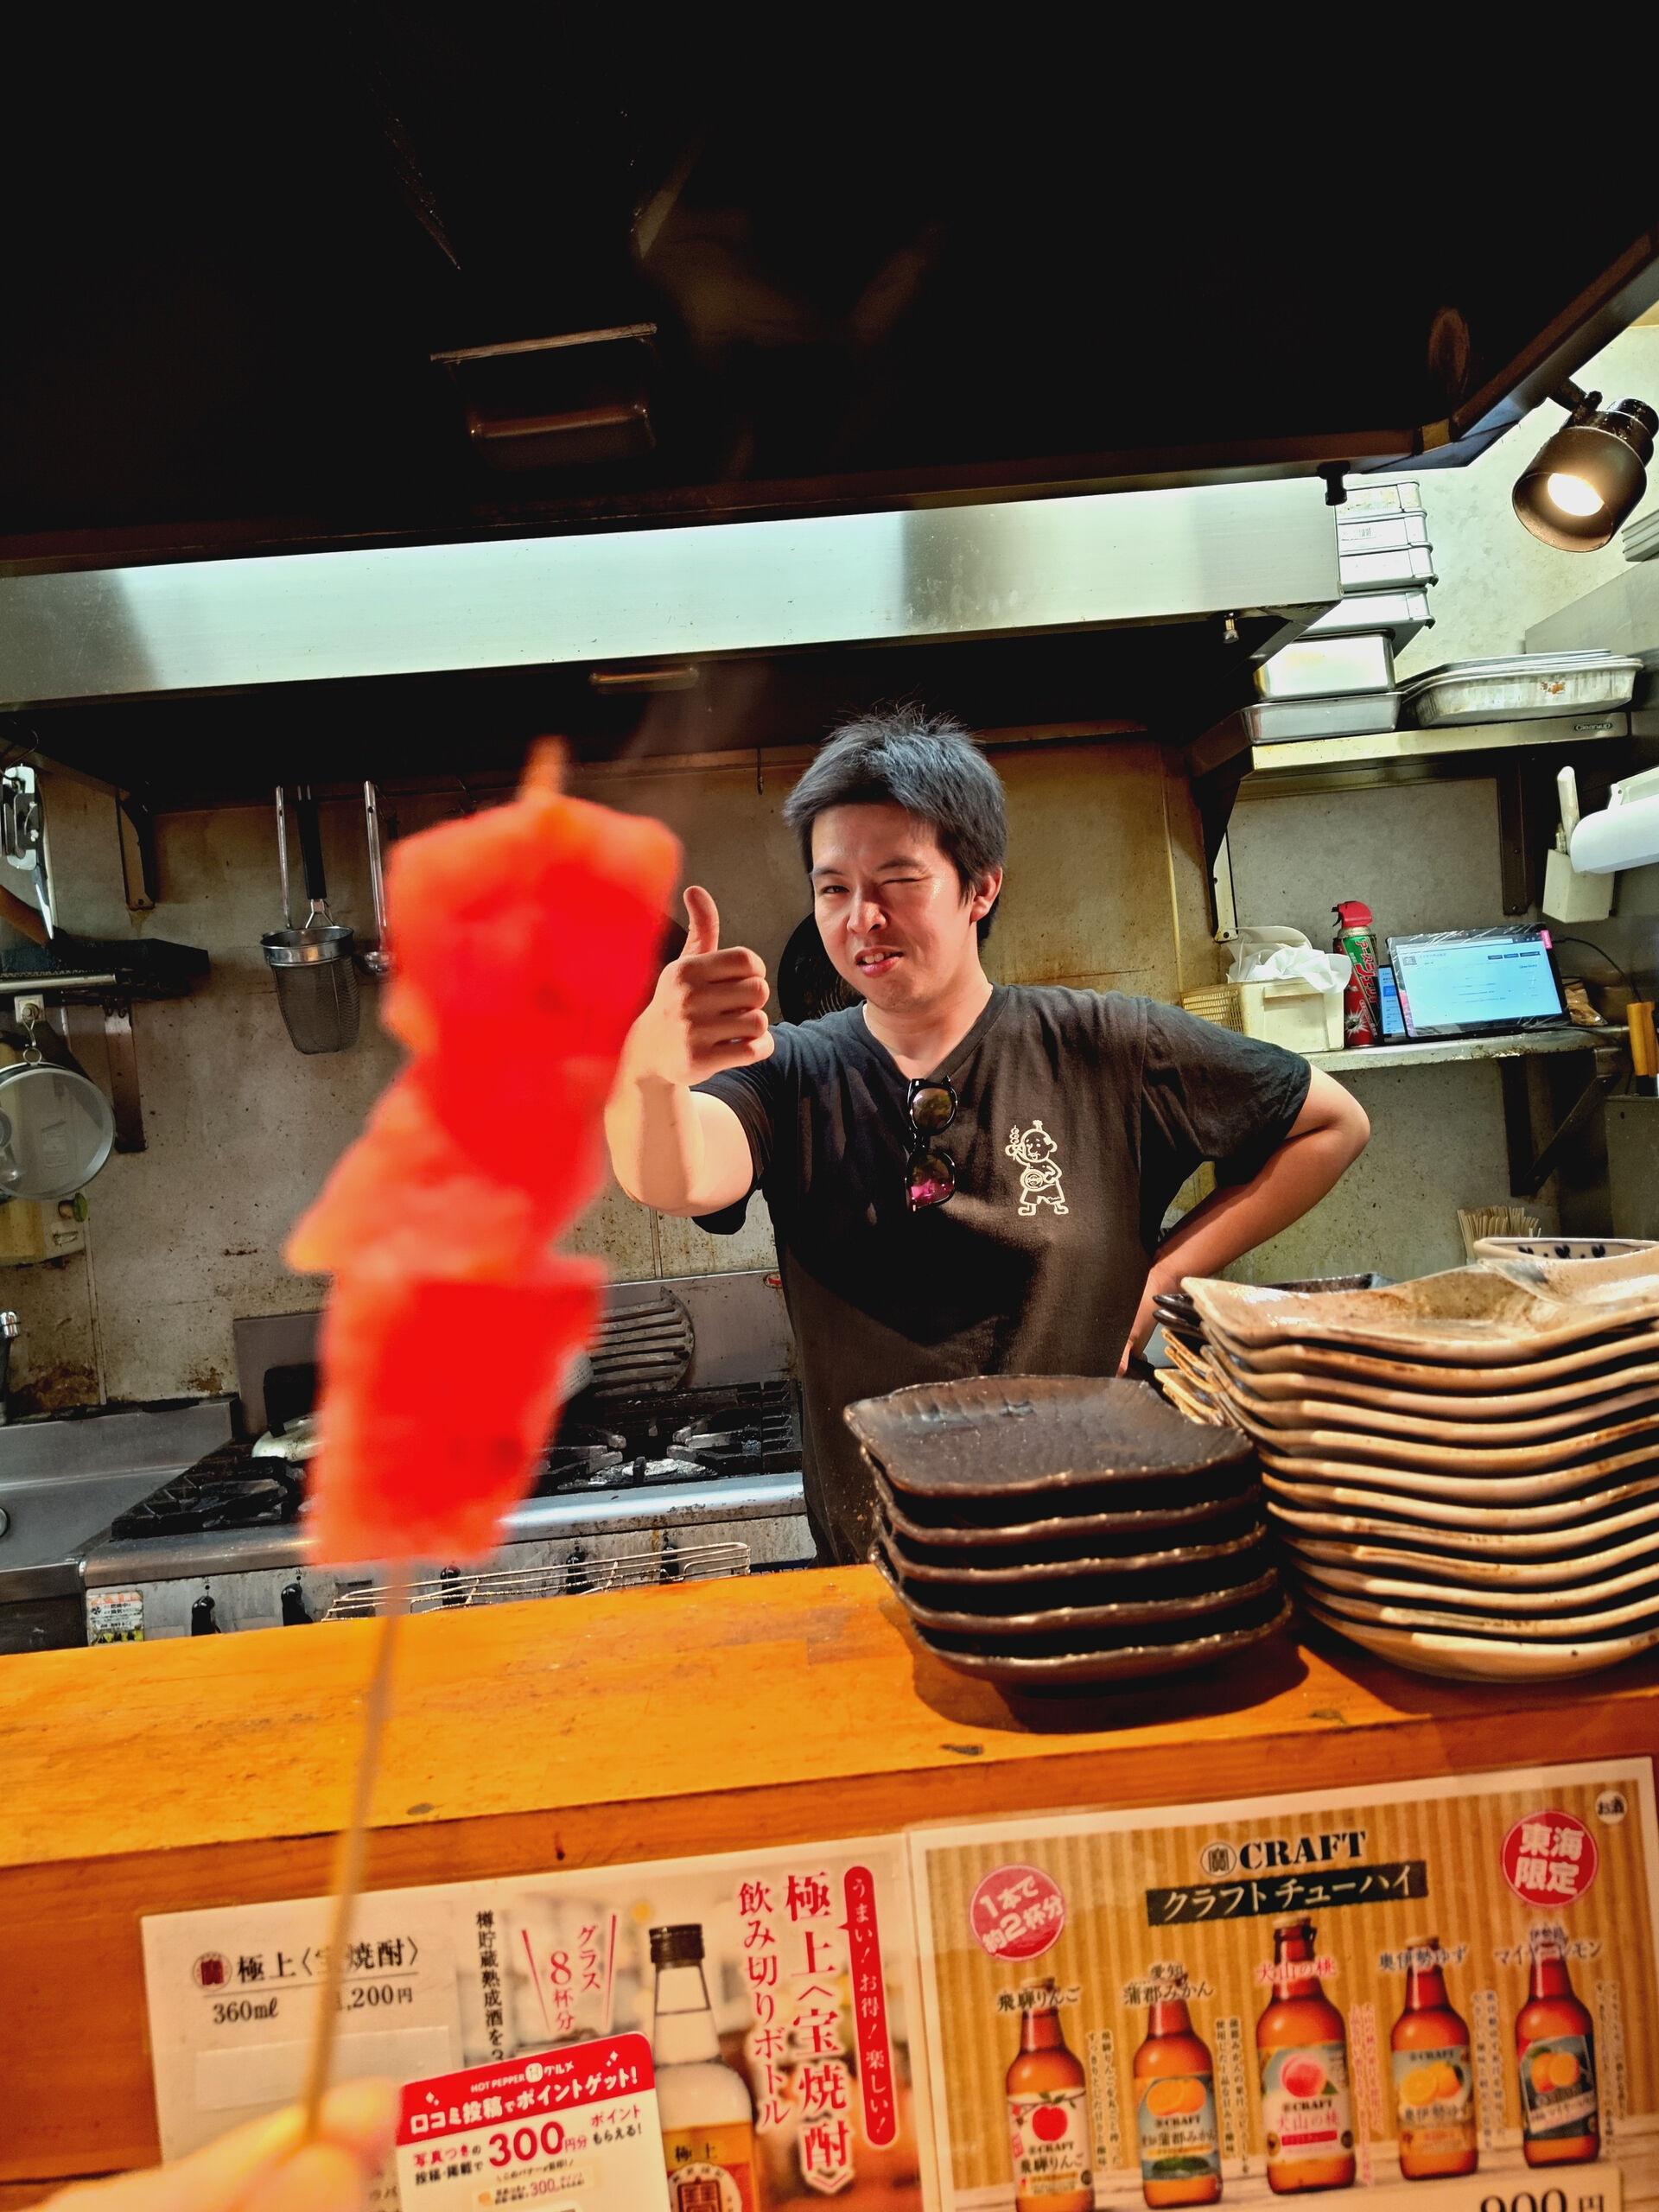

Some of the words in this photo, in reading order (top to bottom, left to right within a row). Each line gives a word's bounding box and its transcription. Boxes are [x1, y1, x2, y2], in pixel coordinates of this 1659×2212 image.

[1239, 1831, 1366, 1870] CRAFT
[1518, 1822, 1586, 1862] 東海
[1163, 1865, 1411, 1923] クラフトチューハイ
[1514, 1856, 1580, 1895] 限定
[979, 1875, 1039, 1919] 1本で
[982, 1894, 1063, 1954] 約2杯分
[577, 1924, 601, 1993] グラス
[1259, 1957, 1337, 1984] 犬山の桃
[550, 1950, 575, 2031] 8杯分
[739, 1880, 792, 2127] 飲み切りボトル
[998, 1986, 1082, 2012] 飛騨りんご
[470, 2082, 491, 2093] HOT
[491, 2073, 526, 2089] PEPPER
[543, 2061, 575, 2075] グルメ
[410, 2065, 639, 2135] 口コミ投稿でポイントゲット!
[590, 2104, 642, 2128] ポイント
[593, 2122, 643, 2146] もらえる!
[414, 2145, 482, 2168] 写真つきの
